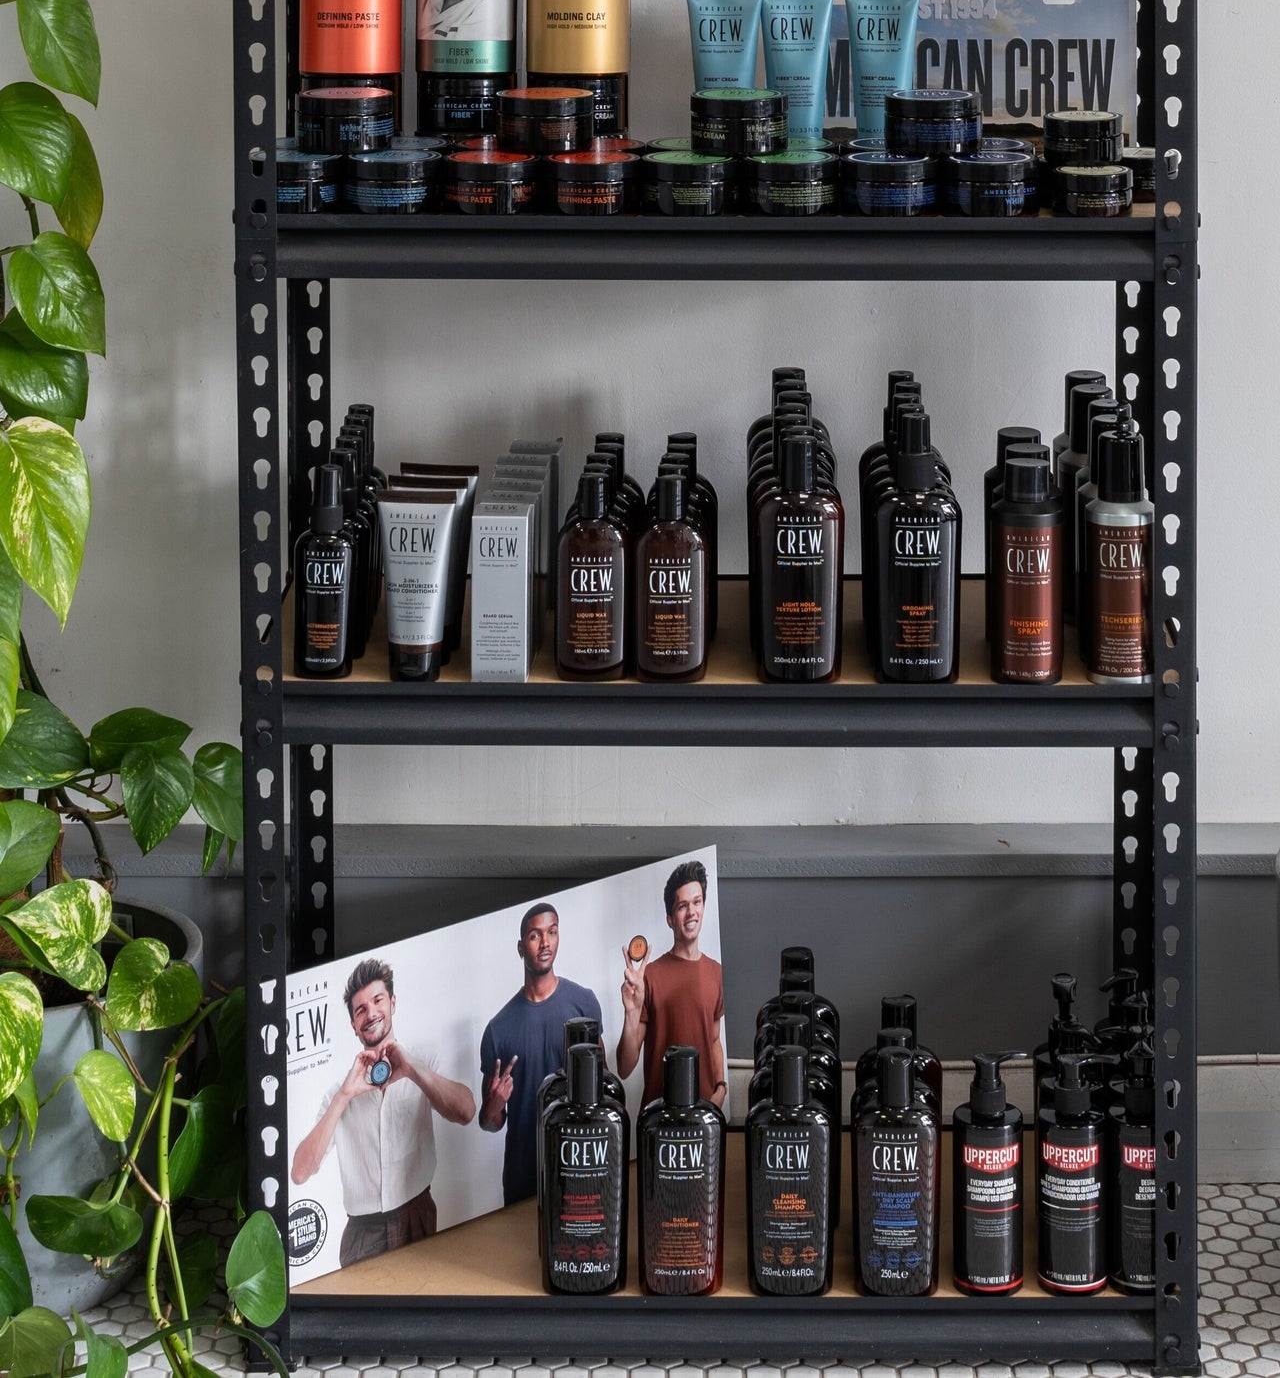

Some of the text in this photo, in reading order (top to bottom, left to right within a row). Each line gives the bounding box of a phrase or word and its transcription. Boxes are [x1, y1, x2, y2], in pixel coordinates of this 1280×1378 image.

[317, 12, 380, 21] DEFINING PASTE
[547, 12, 606, 21] MOLDING CLAY
[1005, 37, 1116, 118] CREW
[703, 131, 725, 140] CREAM
[594, 196, 616, 204] PASTE
[291, 981, 328, 1000] RICAN
[964, 1145, 1018, 1165] UPPERCUT
[1043, 1142, 1097, 1162] UPPERCUT
[1125, 1147, 1156, 1163] UPPE
[970, 1178, 993, 1188] EVERYDAY
[289, 1213, 316, 1230] MERICA'S
[299, 1232, 316, 1245] BRAND
